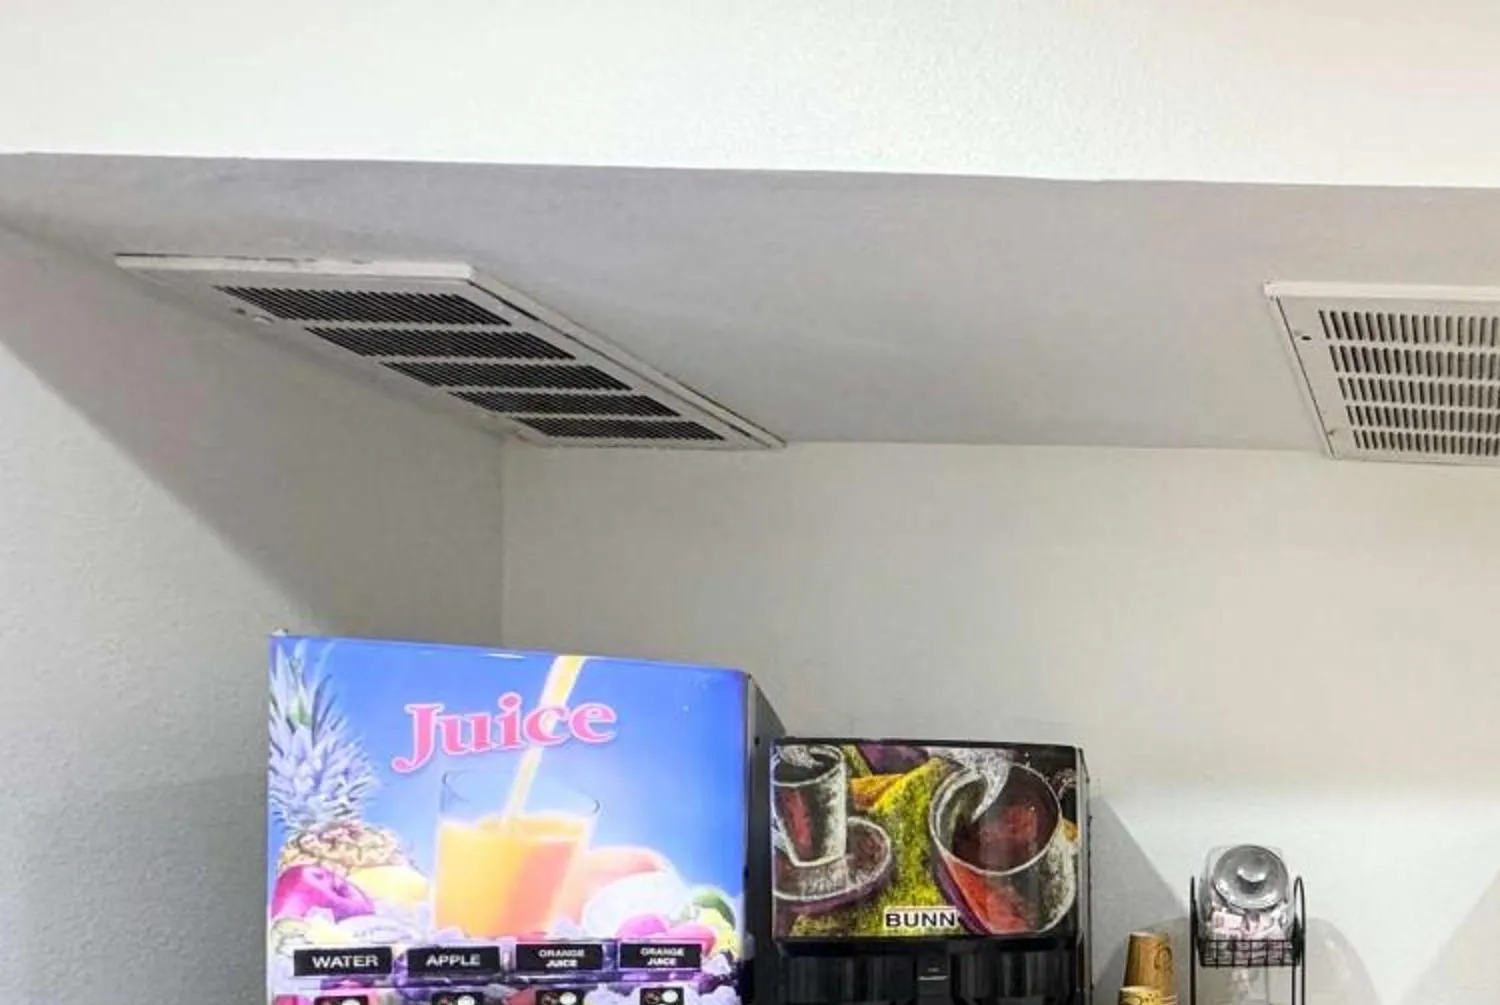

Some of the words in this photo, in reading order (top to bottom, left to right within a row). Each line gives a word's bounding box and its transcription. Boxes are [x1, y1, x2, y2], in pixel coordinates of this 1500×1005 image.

[390, 692, 617, 773] Juice
[885, 912, 956, 928] BUNN
[538, 949, 585, 958] ORANGE
[640, 947, 685, 957] ORANGE
[312, 954, 380, 968] WATER
[426, 953, 481, 967] APPLE
[546, 959, 578, 968] JUICE
[647, 957, 677, 967] JUICE
